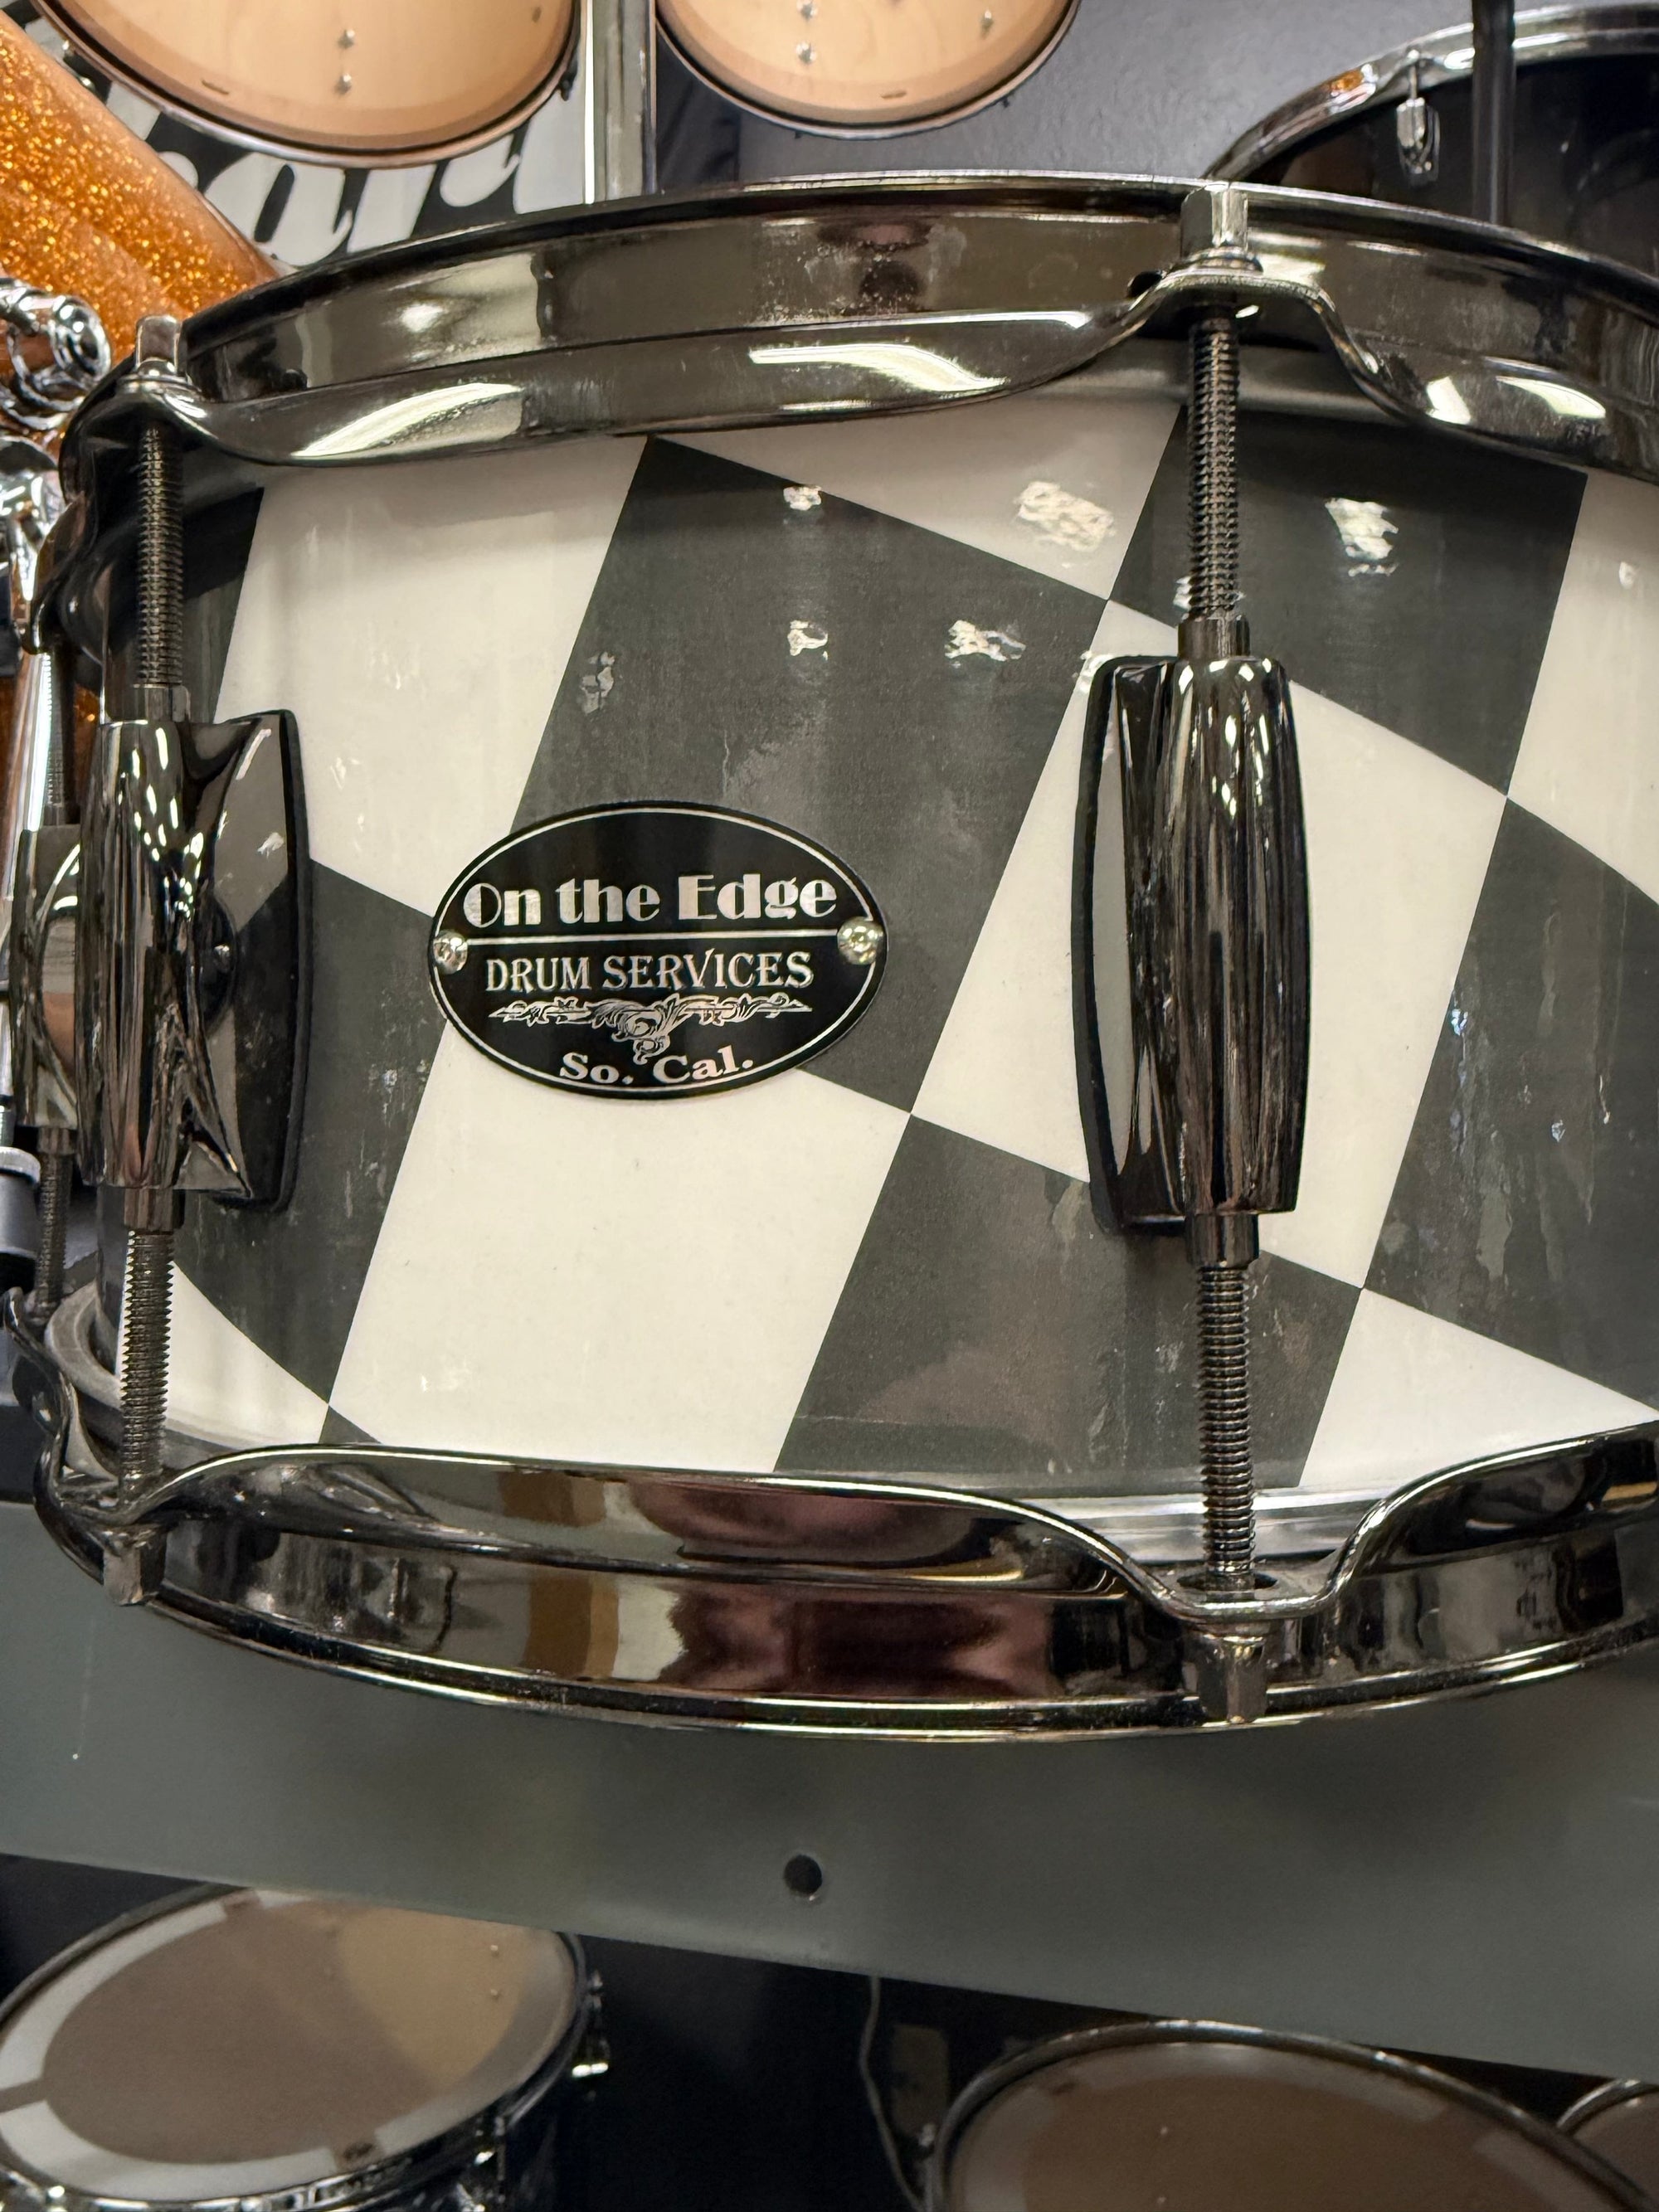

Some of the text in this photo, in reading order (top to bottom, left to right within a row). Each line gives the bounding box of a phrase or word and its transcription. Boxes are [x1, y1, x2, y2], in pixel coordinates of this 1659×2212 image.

[463, 873, 837, 928] On the Edge
[485, 949, 815, 993] DRUM SERVICES
[559, 1045, 754, 1085] So. Cal.
